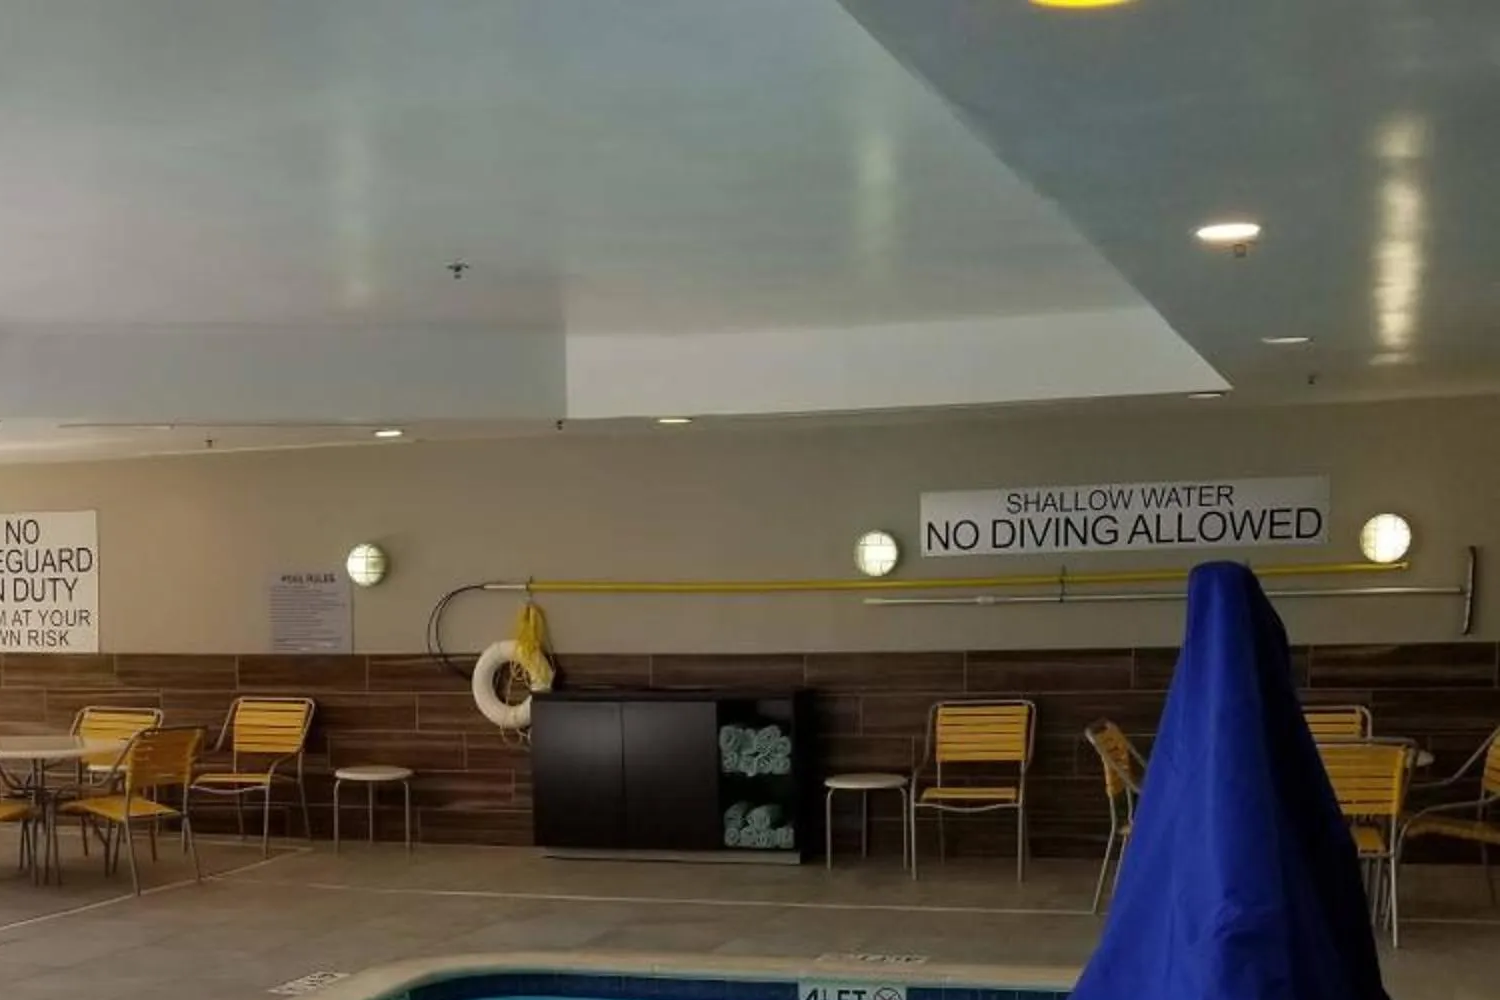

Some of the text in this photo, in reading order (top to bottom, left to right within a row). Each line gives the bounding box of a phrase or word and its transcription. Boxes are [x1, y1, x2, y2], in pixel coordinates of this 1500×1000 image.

[1006, 485, 1234, 514] SHALLOW WATER
[5, 519, 40, 545] NO
[926, 507, 1322, 550] NO DIVING ALLOWED
[13, 577, 78, 603] DUTY
[11, 609, 32, 627] AT
[38, 609, 91, 627] YOUR
[27, 628, 69, 647] RISK
